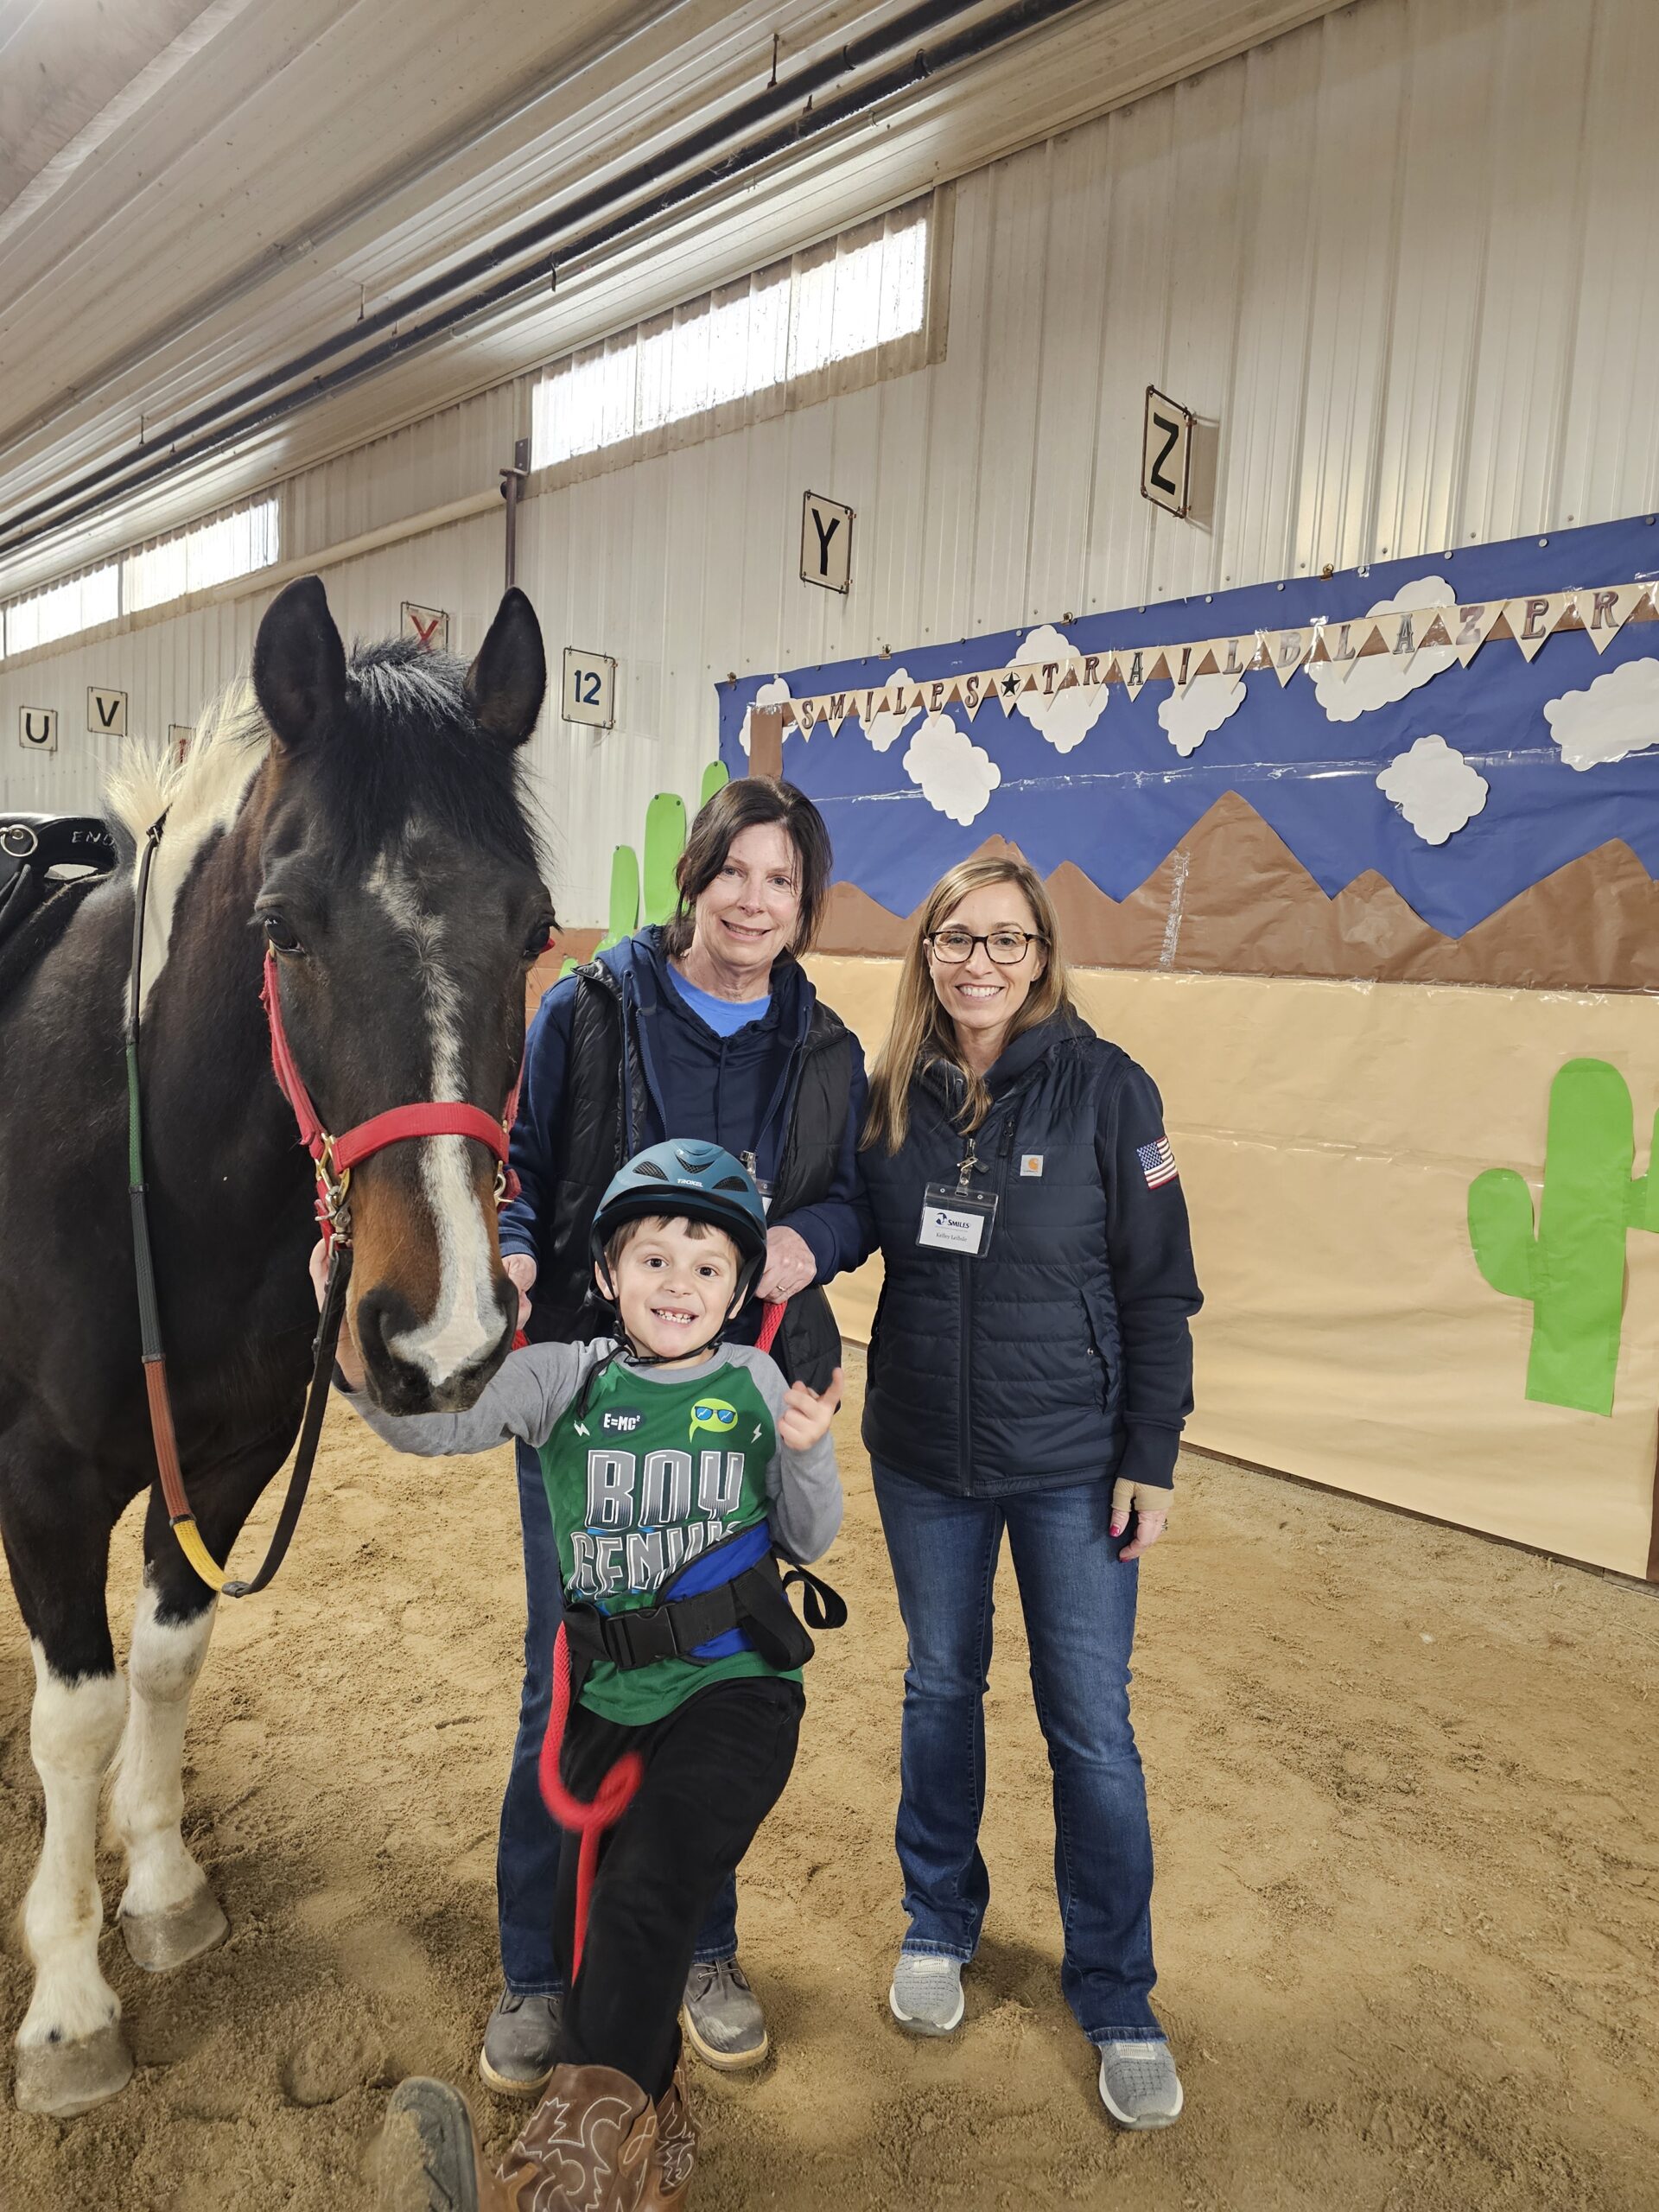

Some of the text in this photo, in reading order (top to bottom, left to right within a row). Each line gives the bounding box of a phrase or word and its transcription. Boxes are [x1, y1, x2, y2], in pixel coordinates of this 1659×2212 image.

[1151, 411, 1179, 496] Z
[810, 507, 841, 575] Y
[800, 589, 1623, 731] SMILES TRAILBLAZER
[95, 696, 120, 728] V
[574, 669, 602, 707] 12
[25, 713, 50, 744] U
[677, 1178, 704, 1188] TROXEL
[947, 1218, 970, 1229] SMILES
[585, 1448, 746, 1532] BOY
[567, 1521, 742, 1601] GENIU
